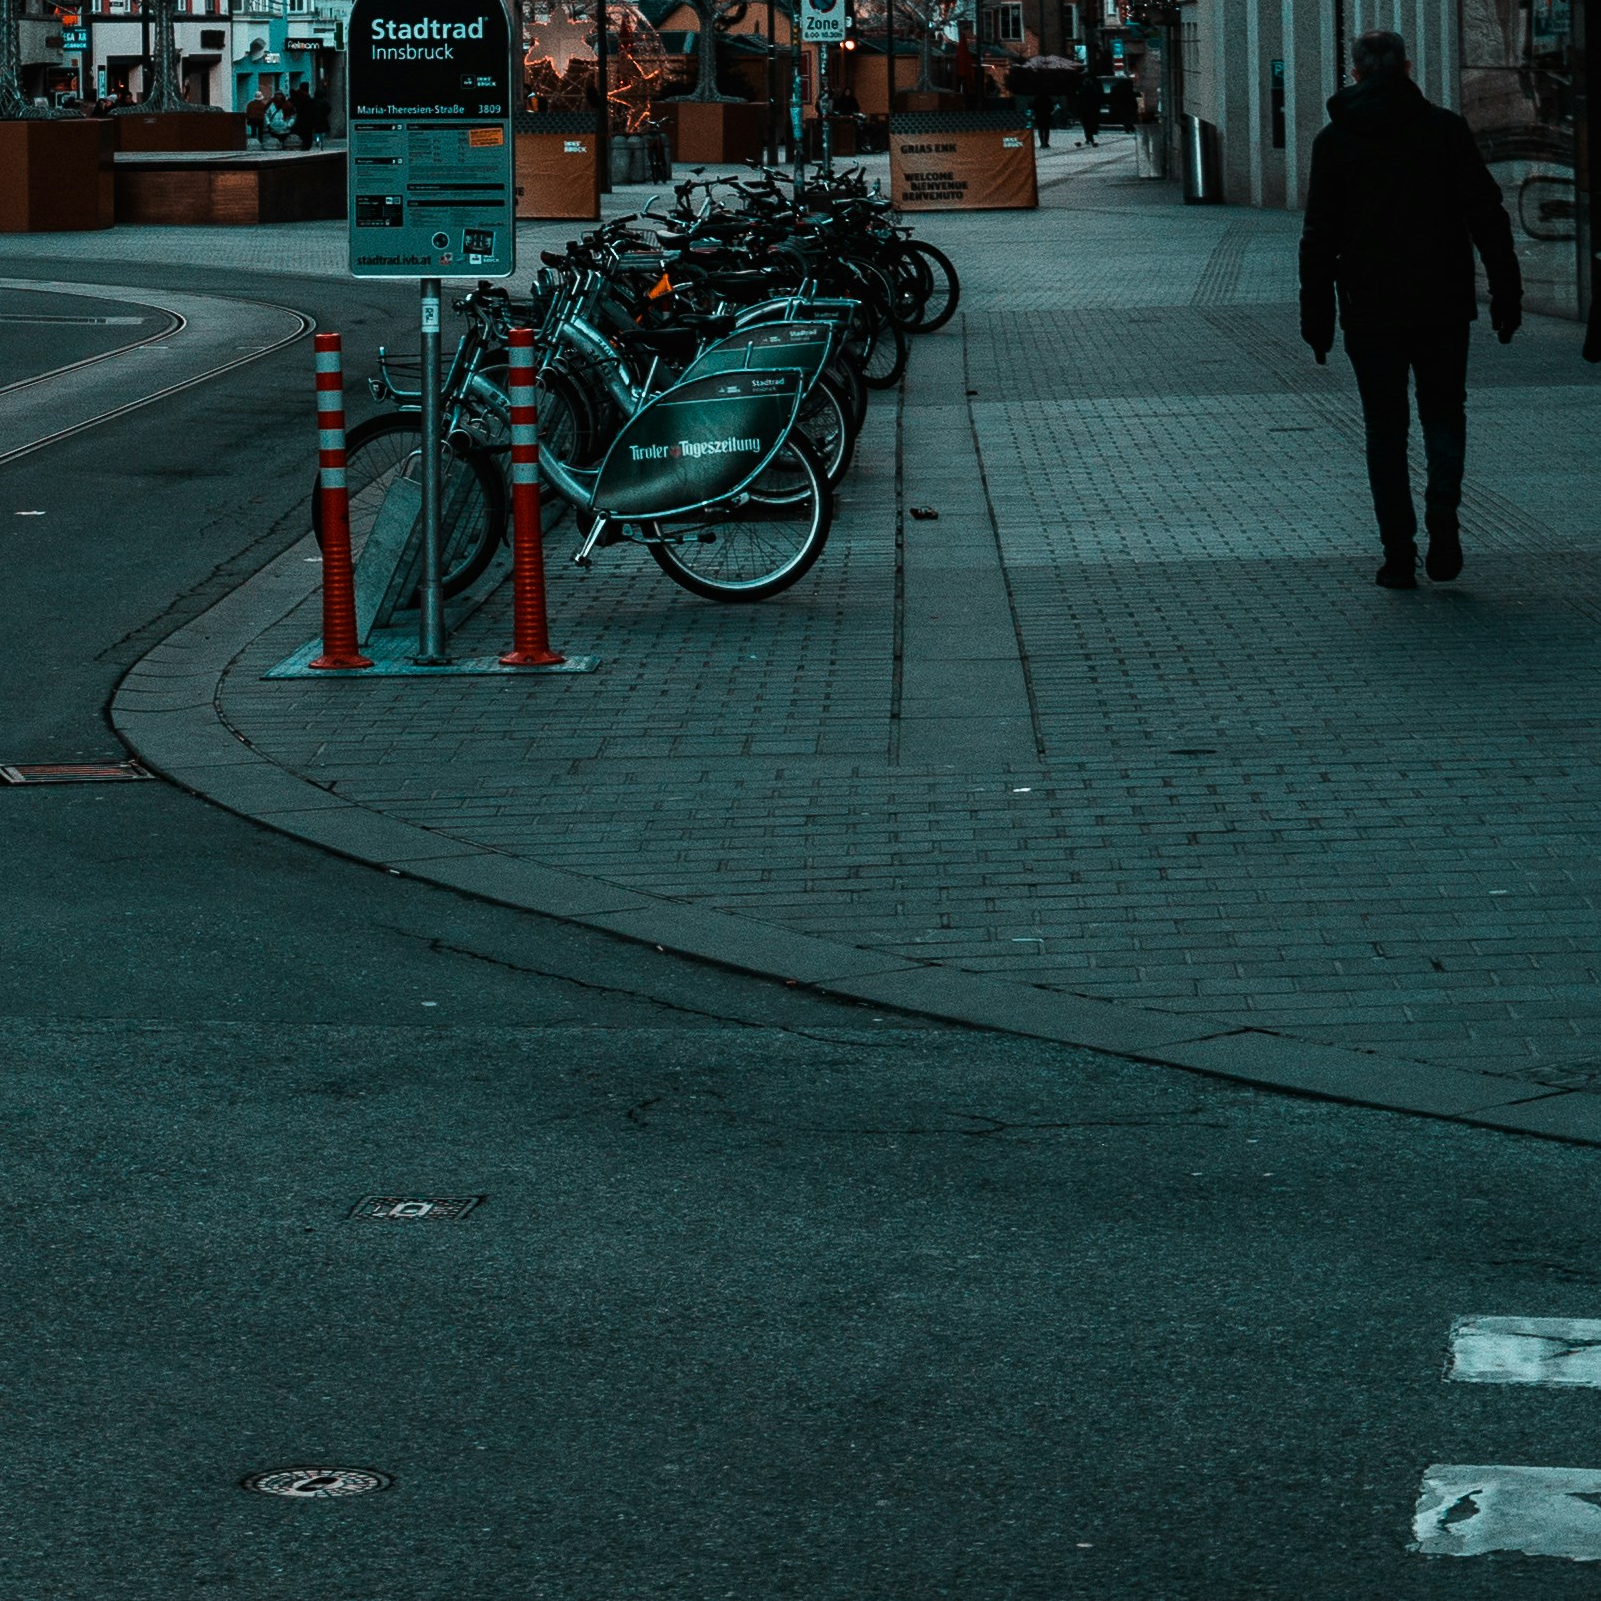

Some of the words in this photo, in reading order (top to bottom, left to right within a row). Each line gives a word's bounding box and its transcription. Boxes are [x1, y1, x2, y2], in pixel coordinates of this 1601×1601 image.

[371, 16, 484, 40] Stadtrad
[807, 16, 839, 30] Zone
[372, 43, 454, 60] Innsbruck
[357, 104, 465, 115] Maria-Theresien-Straße
[478, 104, 501, 114] 3809
[901, 143, 933, 154] GRIAS
[934, 143, 957, 153] ENK
[904, 172, 954, 181] WELCOME
[910, 181, 968, 191] BIENVENUE
[902, 191, 964, 201] BENVENUTO
[357, 254, 432, 266] stadtrad.ivb.at
[751, 378, 785, 387] Stadtrad
[629, 443, 669, 461] Tiroler
[679, 436, 760, 458] Tageszeitung
